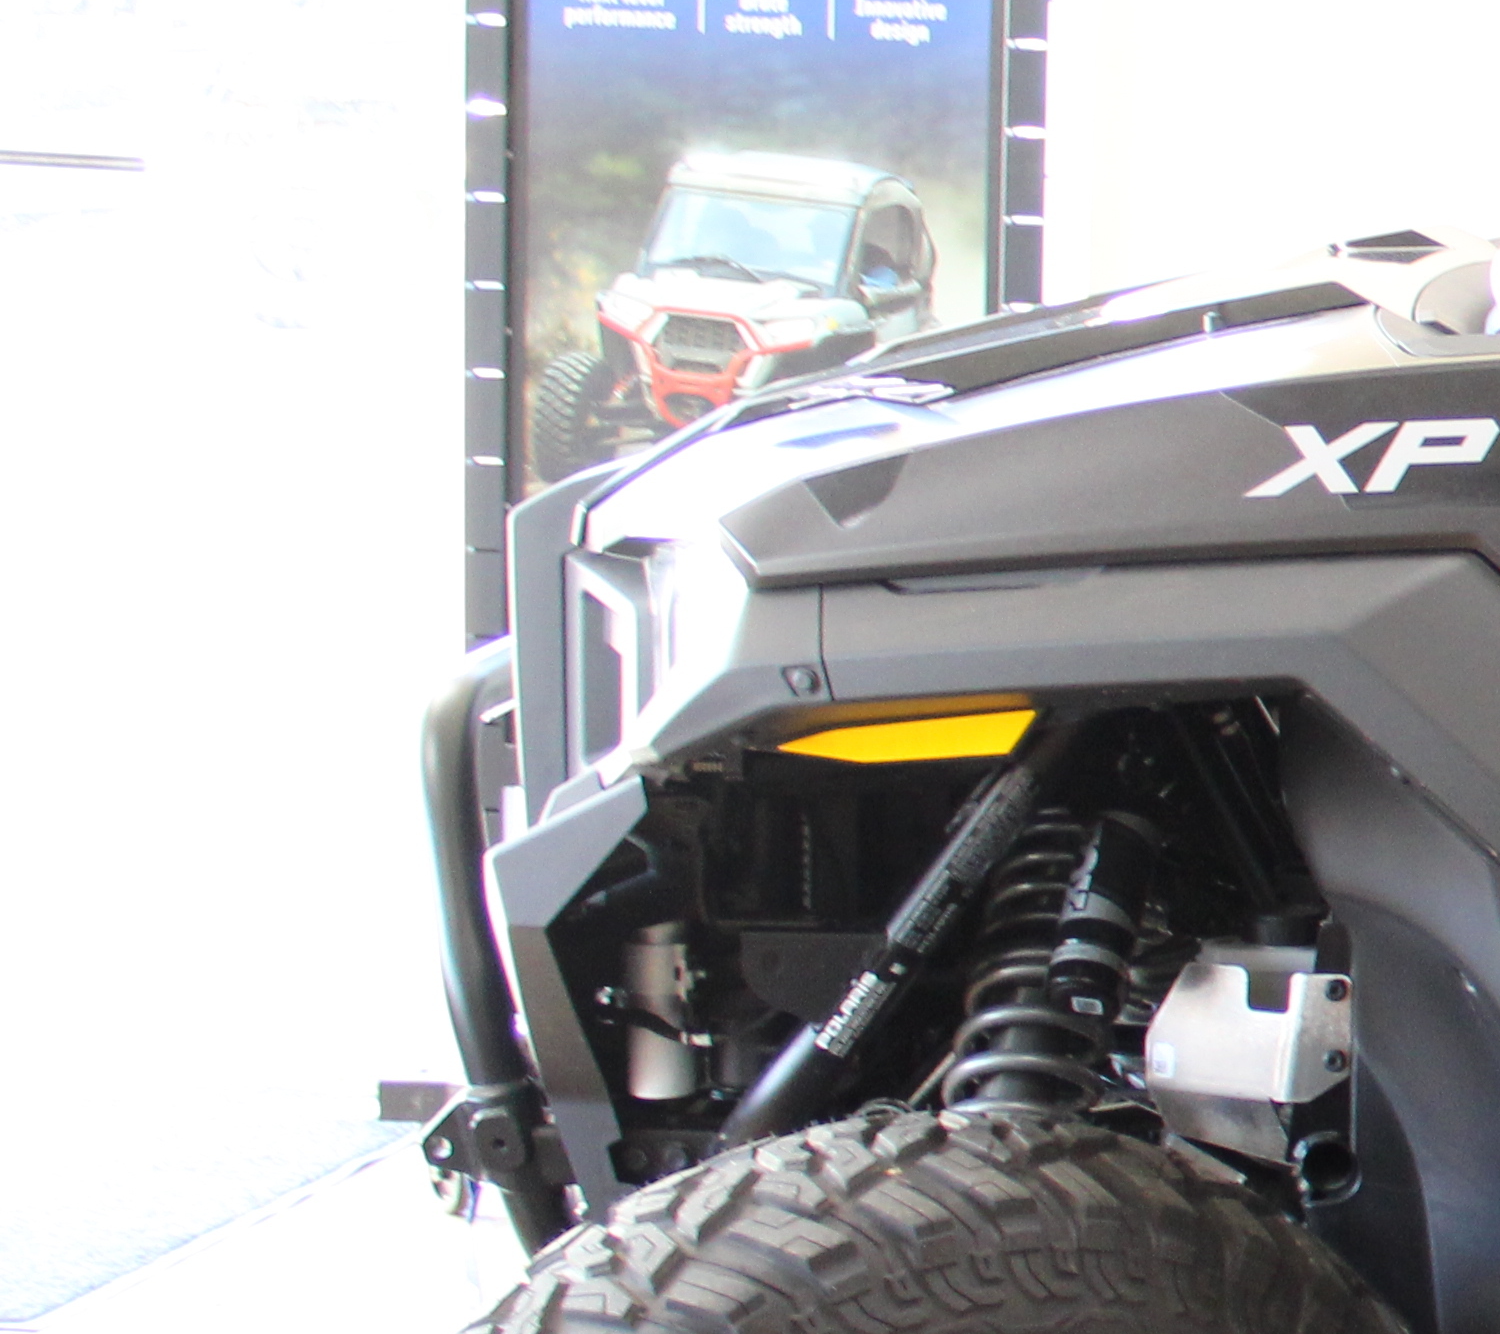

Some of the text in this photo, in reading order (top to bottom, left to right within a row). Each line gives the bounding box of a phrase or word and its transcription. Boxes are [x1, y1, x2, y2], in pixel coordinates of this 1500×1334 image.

[563, 4, 677, 30] performance
[724, 13, 803, 40] strength
[870, 19, 931, 47] design
[1243, 417, 1500, 498] XP
